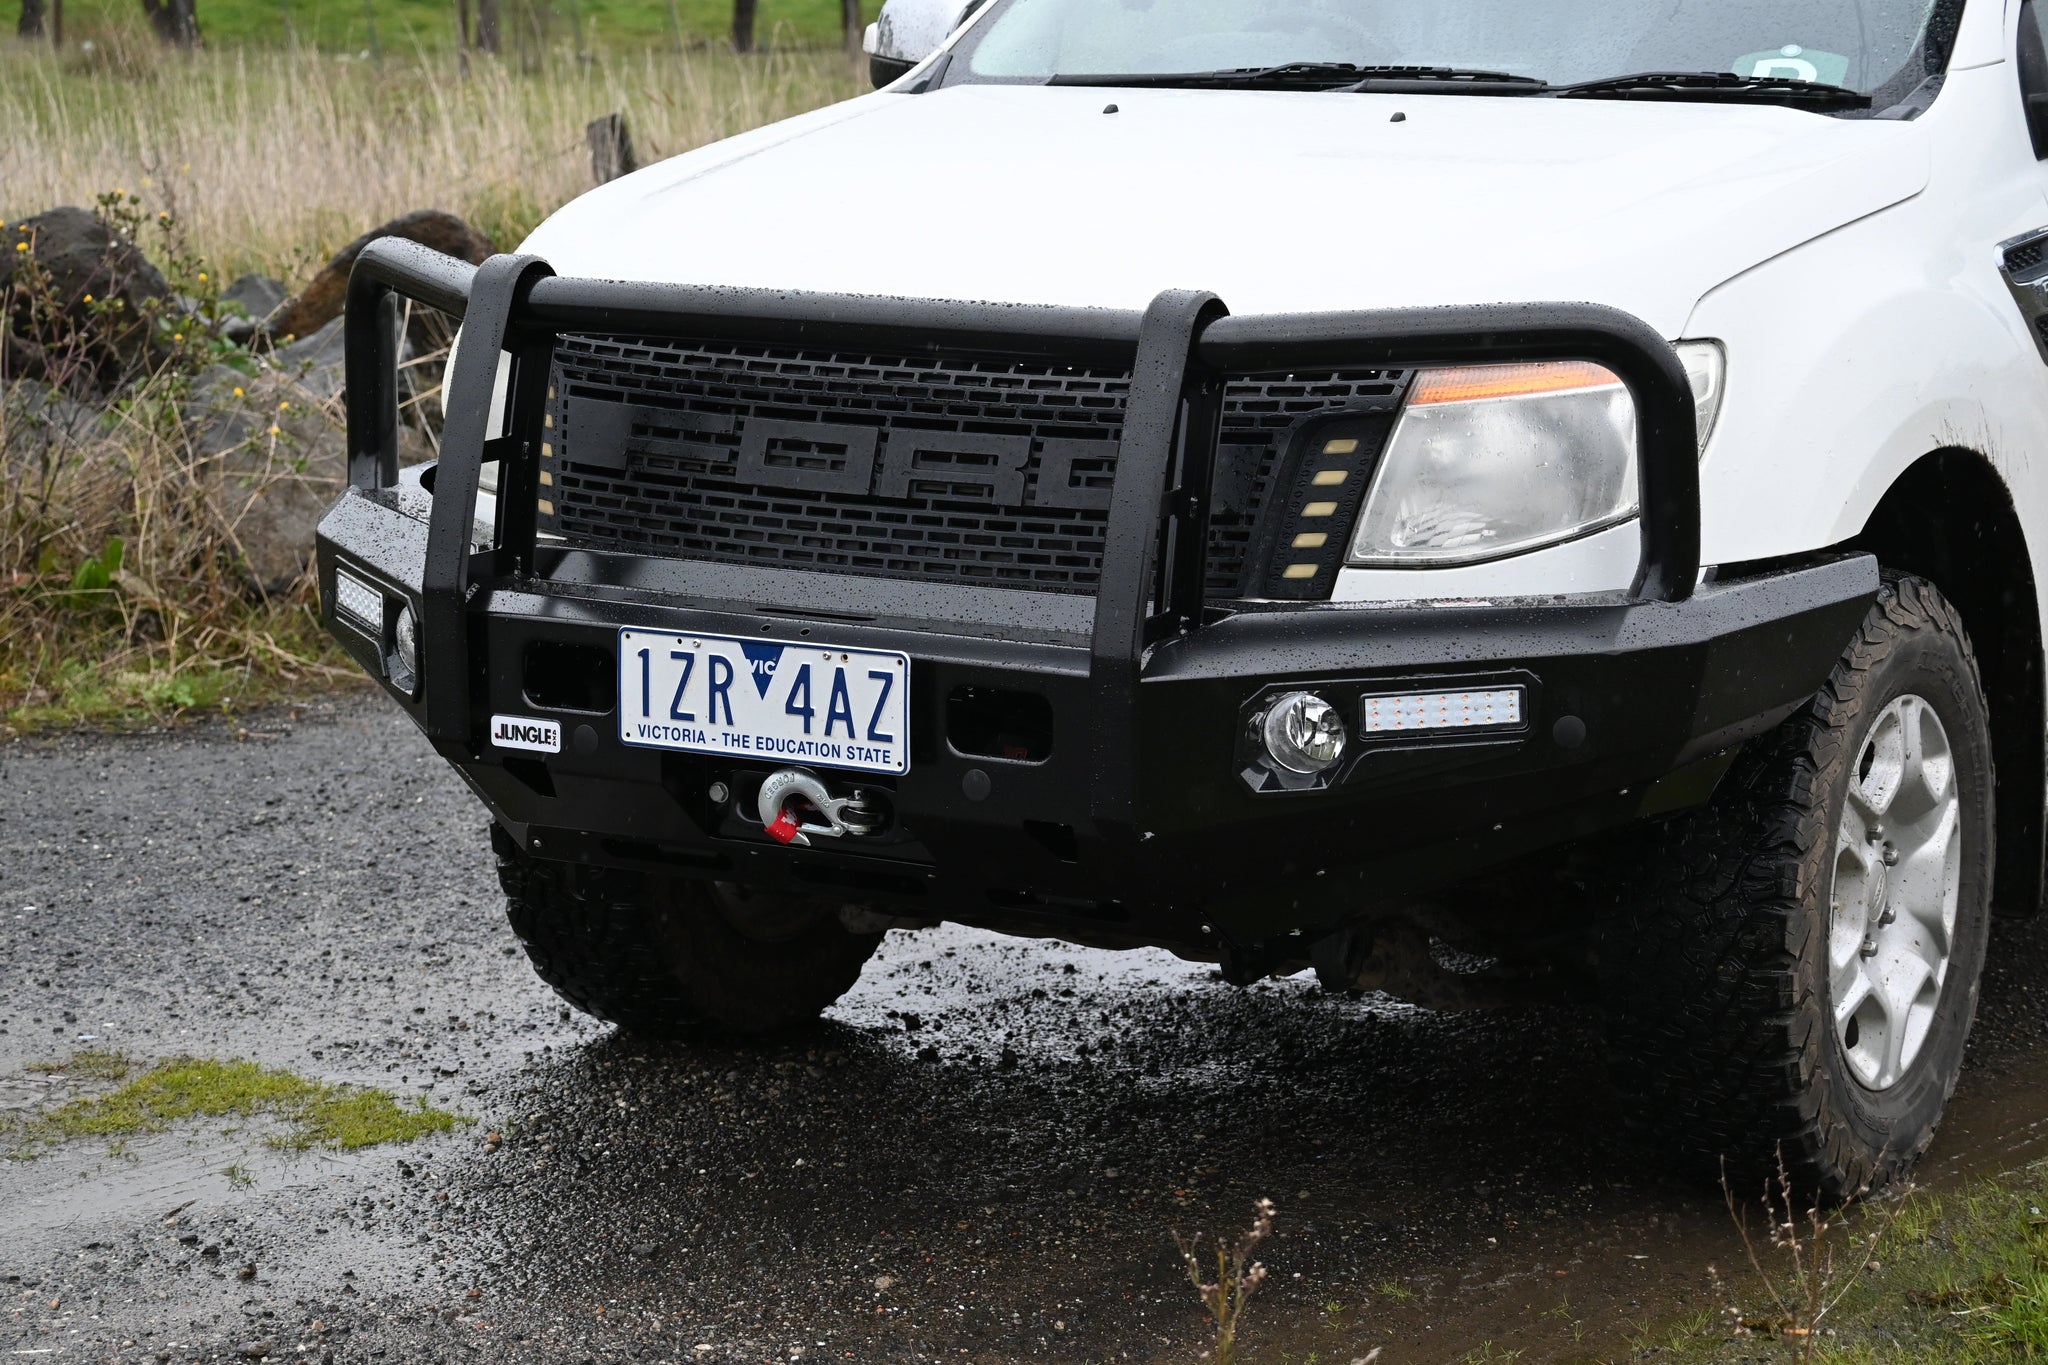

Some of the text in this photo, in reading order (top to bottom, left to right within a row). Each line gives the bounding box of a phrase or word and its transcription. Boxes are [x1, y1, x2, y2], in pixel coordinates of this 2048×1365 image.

[745, 658, 777, 675] VIC
[637, 648, 894, 743] 1ZR 4AZ
[494, 723, 551, 745] JUNGLE
[638, 724, 706, 744] VICTORIA
[722, 732, 750, 748] THE
[756, 736, 840, 758] EDUCATION
[846, 746, 891, 764] STATE
[764, 772, 795, 800] FORGED
